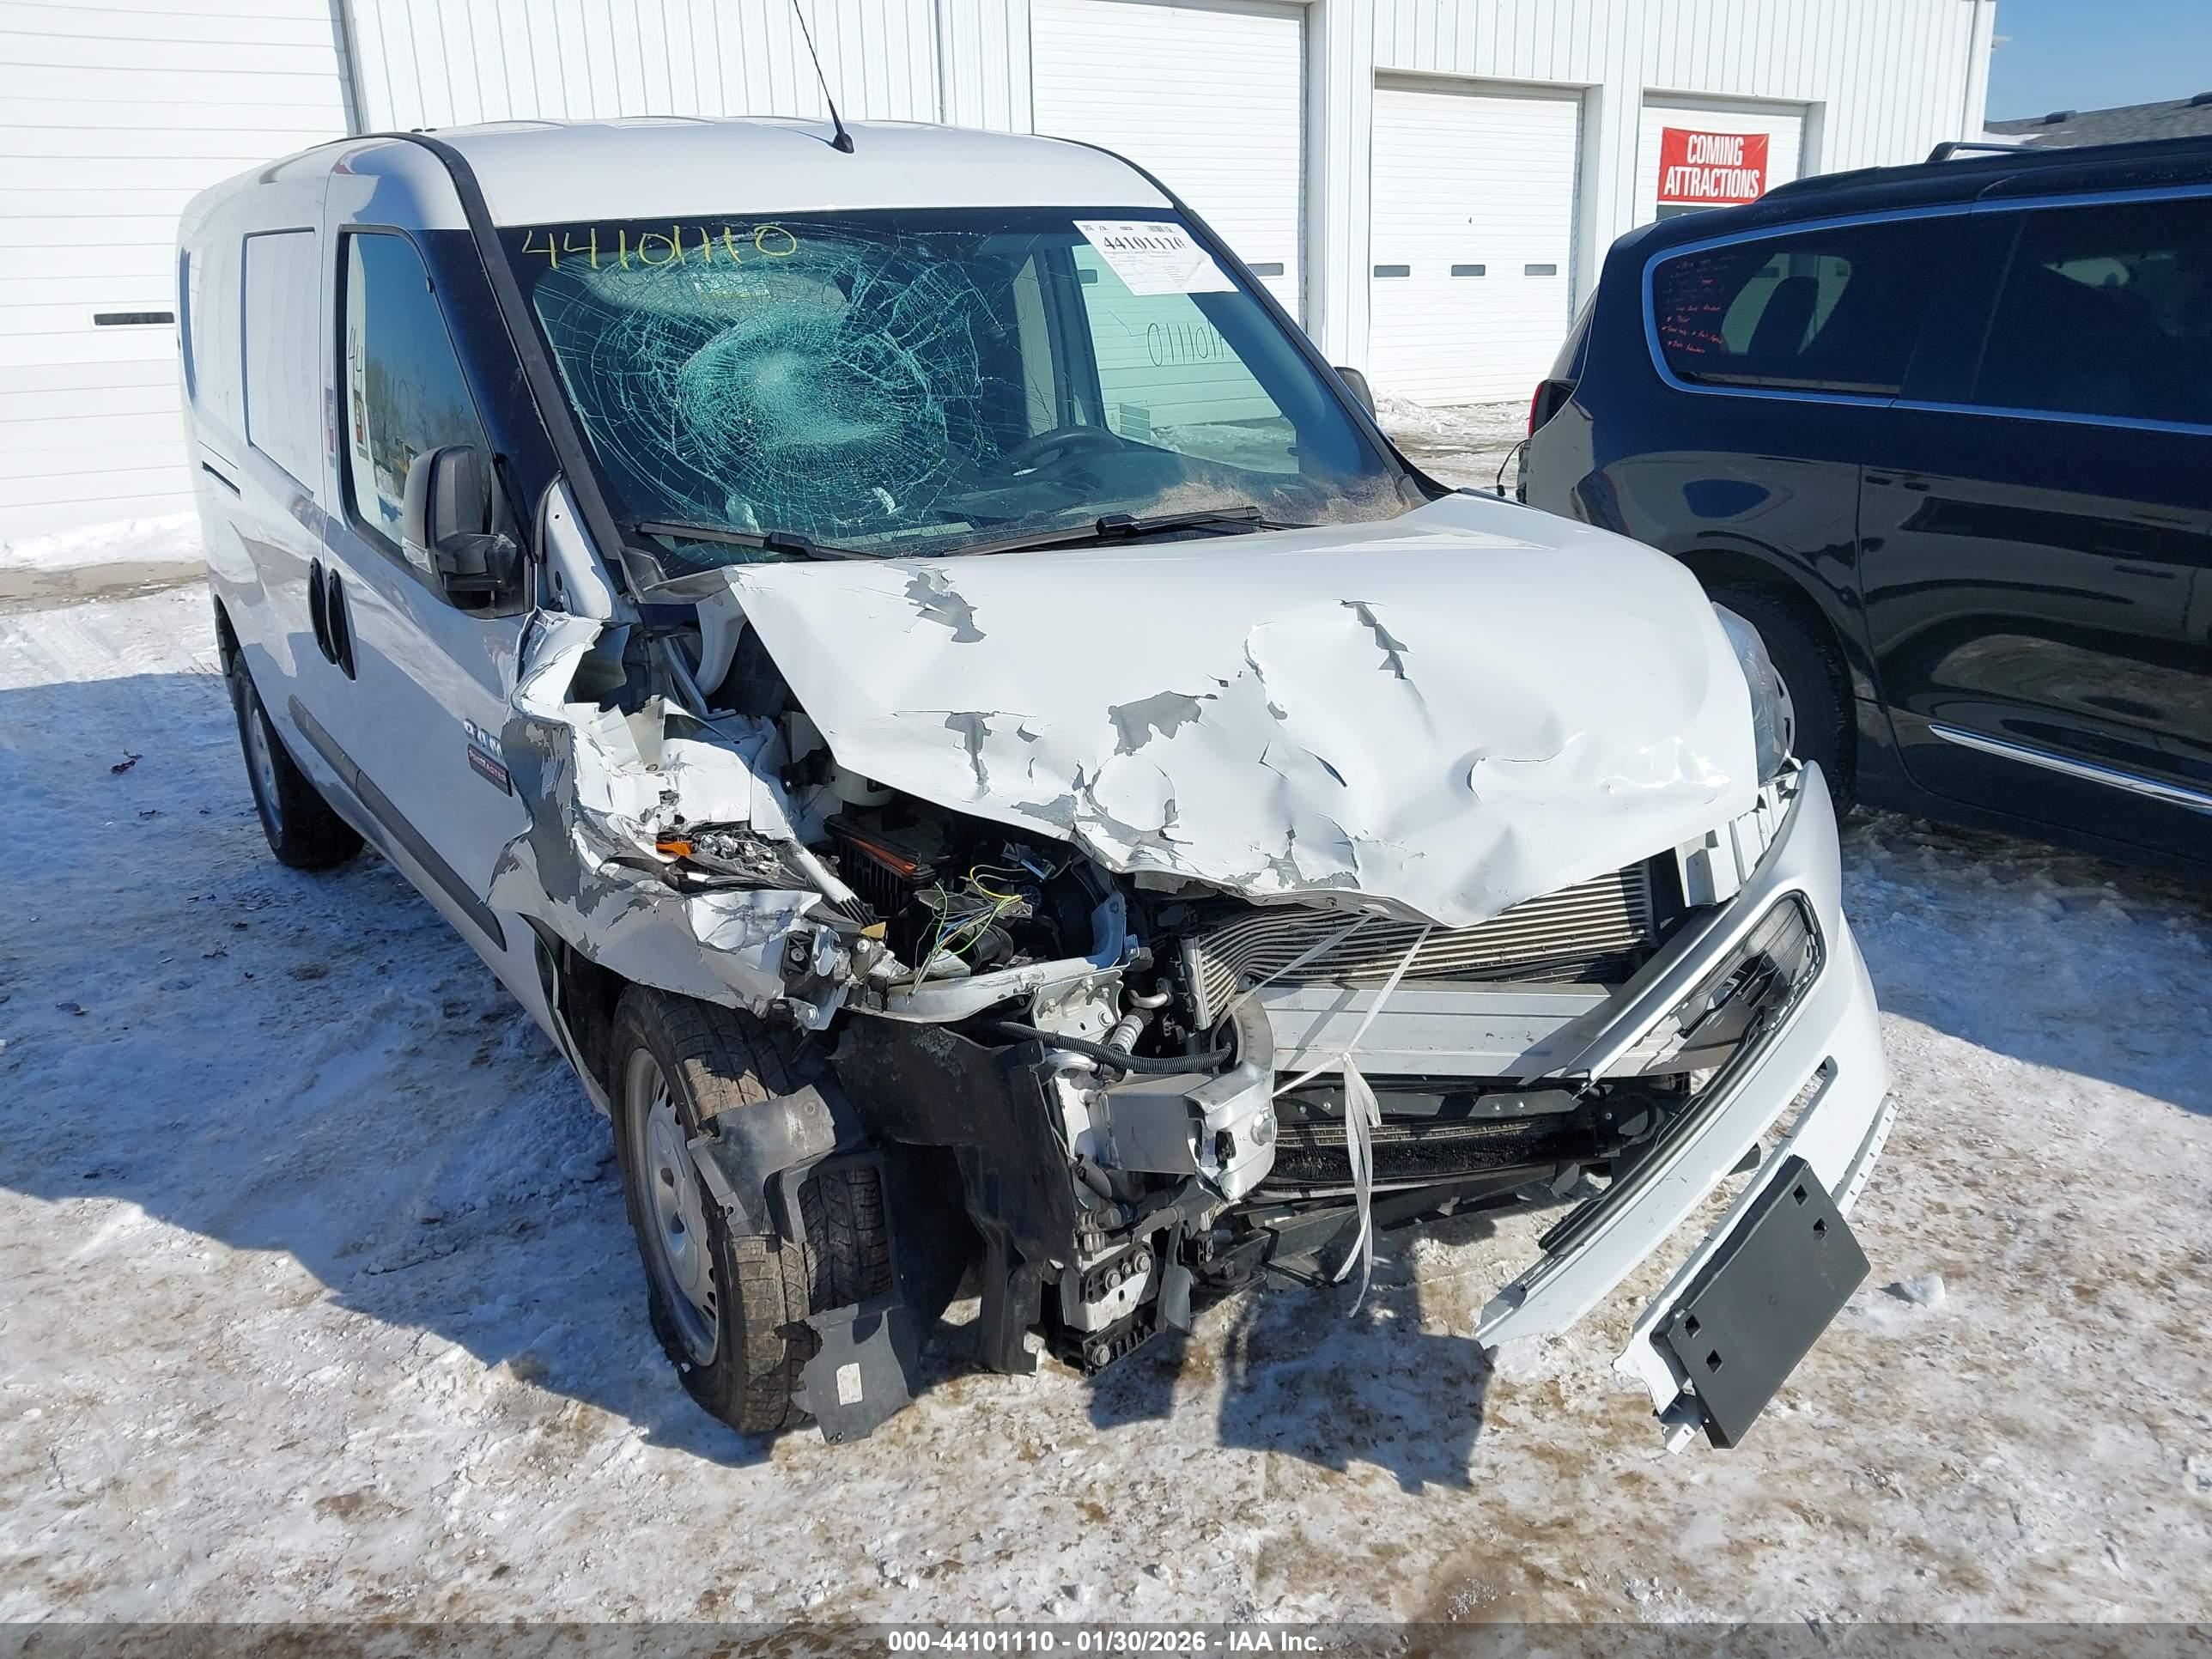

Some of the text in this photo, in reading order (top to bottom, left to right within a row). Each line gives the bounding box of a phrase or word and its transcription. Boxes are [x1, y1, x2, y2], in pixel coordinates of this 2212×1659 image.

[1686, 134, 1744, 166] COMING
[1663, 165, 1759, 198] ATTRACTIONS
[521, 224, 798, 270] 44101110
